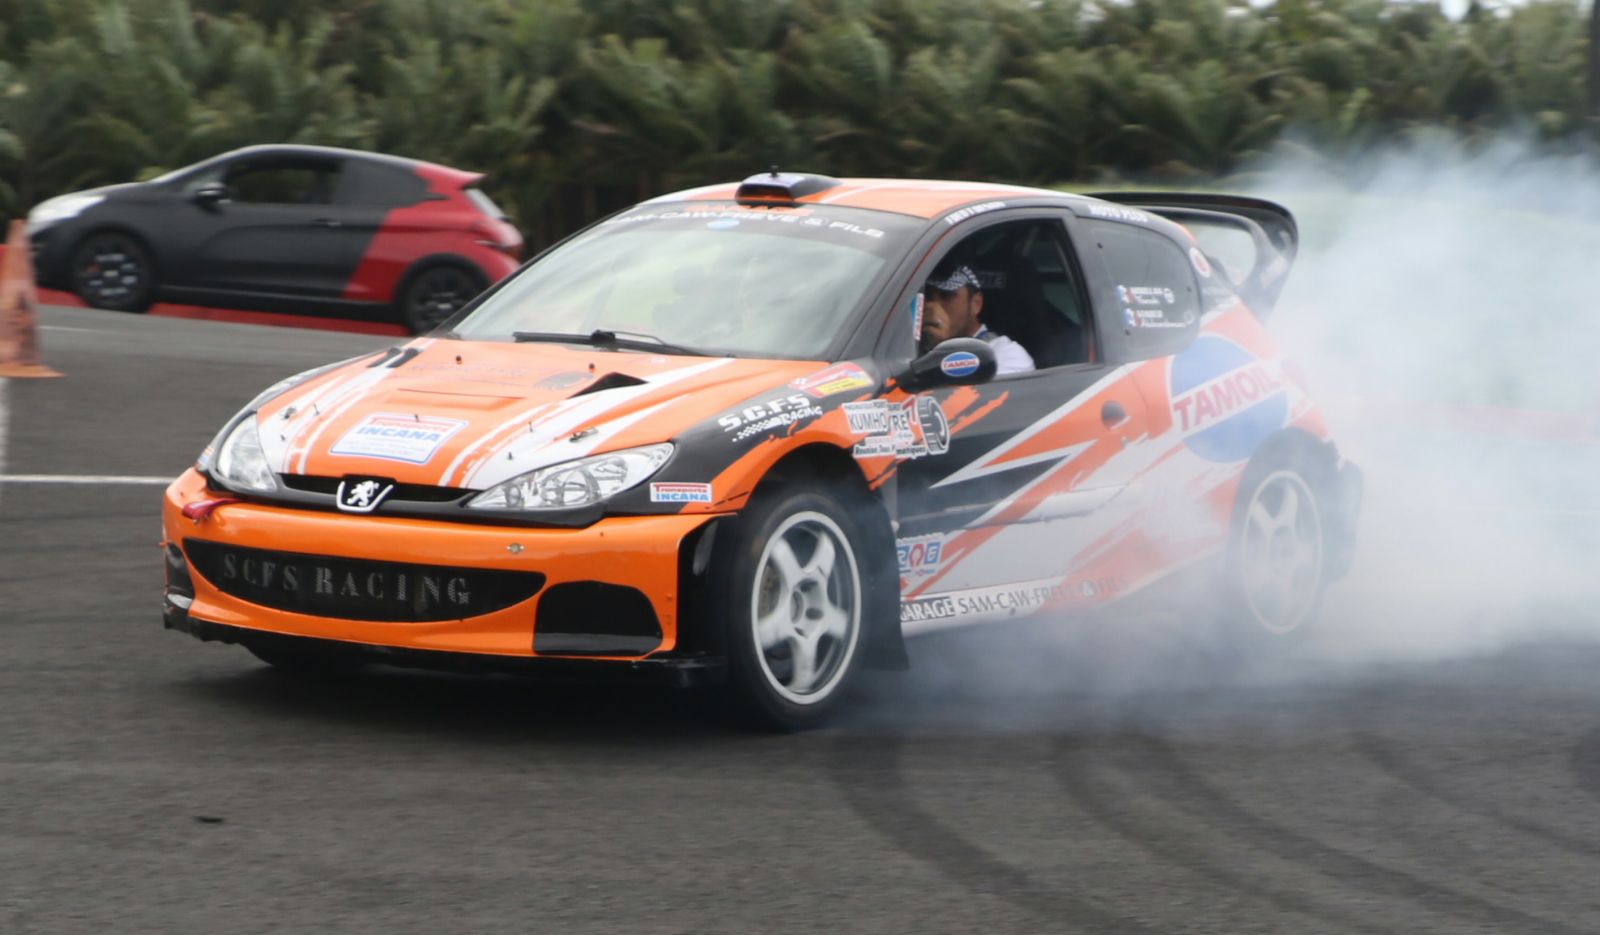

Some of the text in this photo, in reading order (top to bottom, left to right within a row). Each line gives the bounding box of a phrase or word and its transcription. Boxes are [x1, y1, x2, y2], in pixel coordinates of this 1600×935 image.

[830, 220, 885, 237] FILS
[1174, 365, 1280, 432] TAMOIL
[780, 406, 823, 428] RACING
[848, 412, 888, 432] KUMHO
[357, 427, 441, 442] INCANA
[656, 493, 709, 501] INCANA
[223, 553, 472, 605] SCFS RACING
